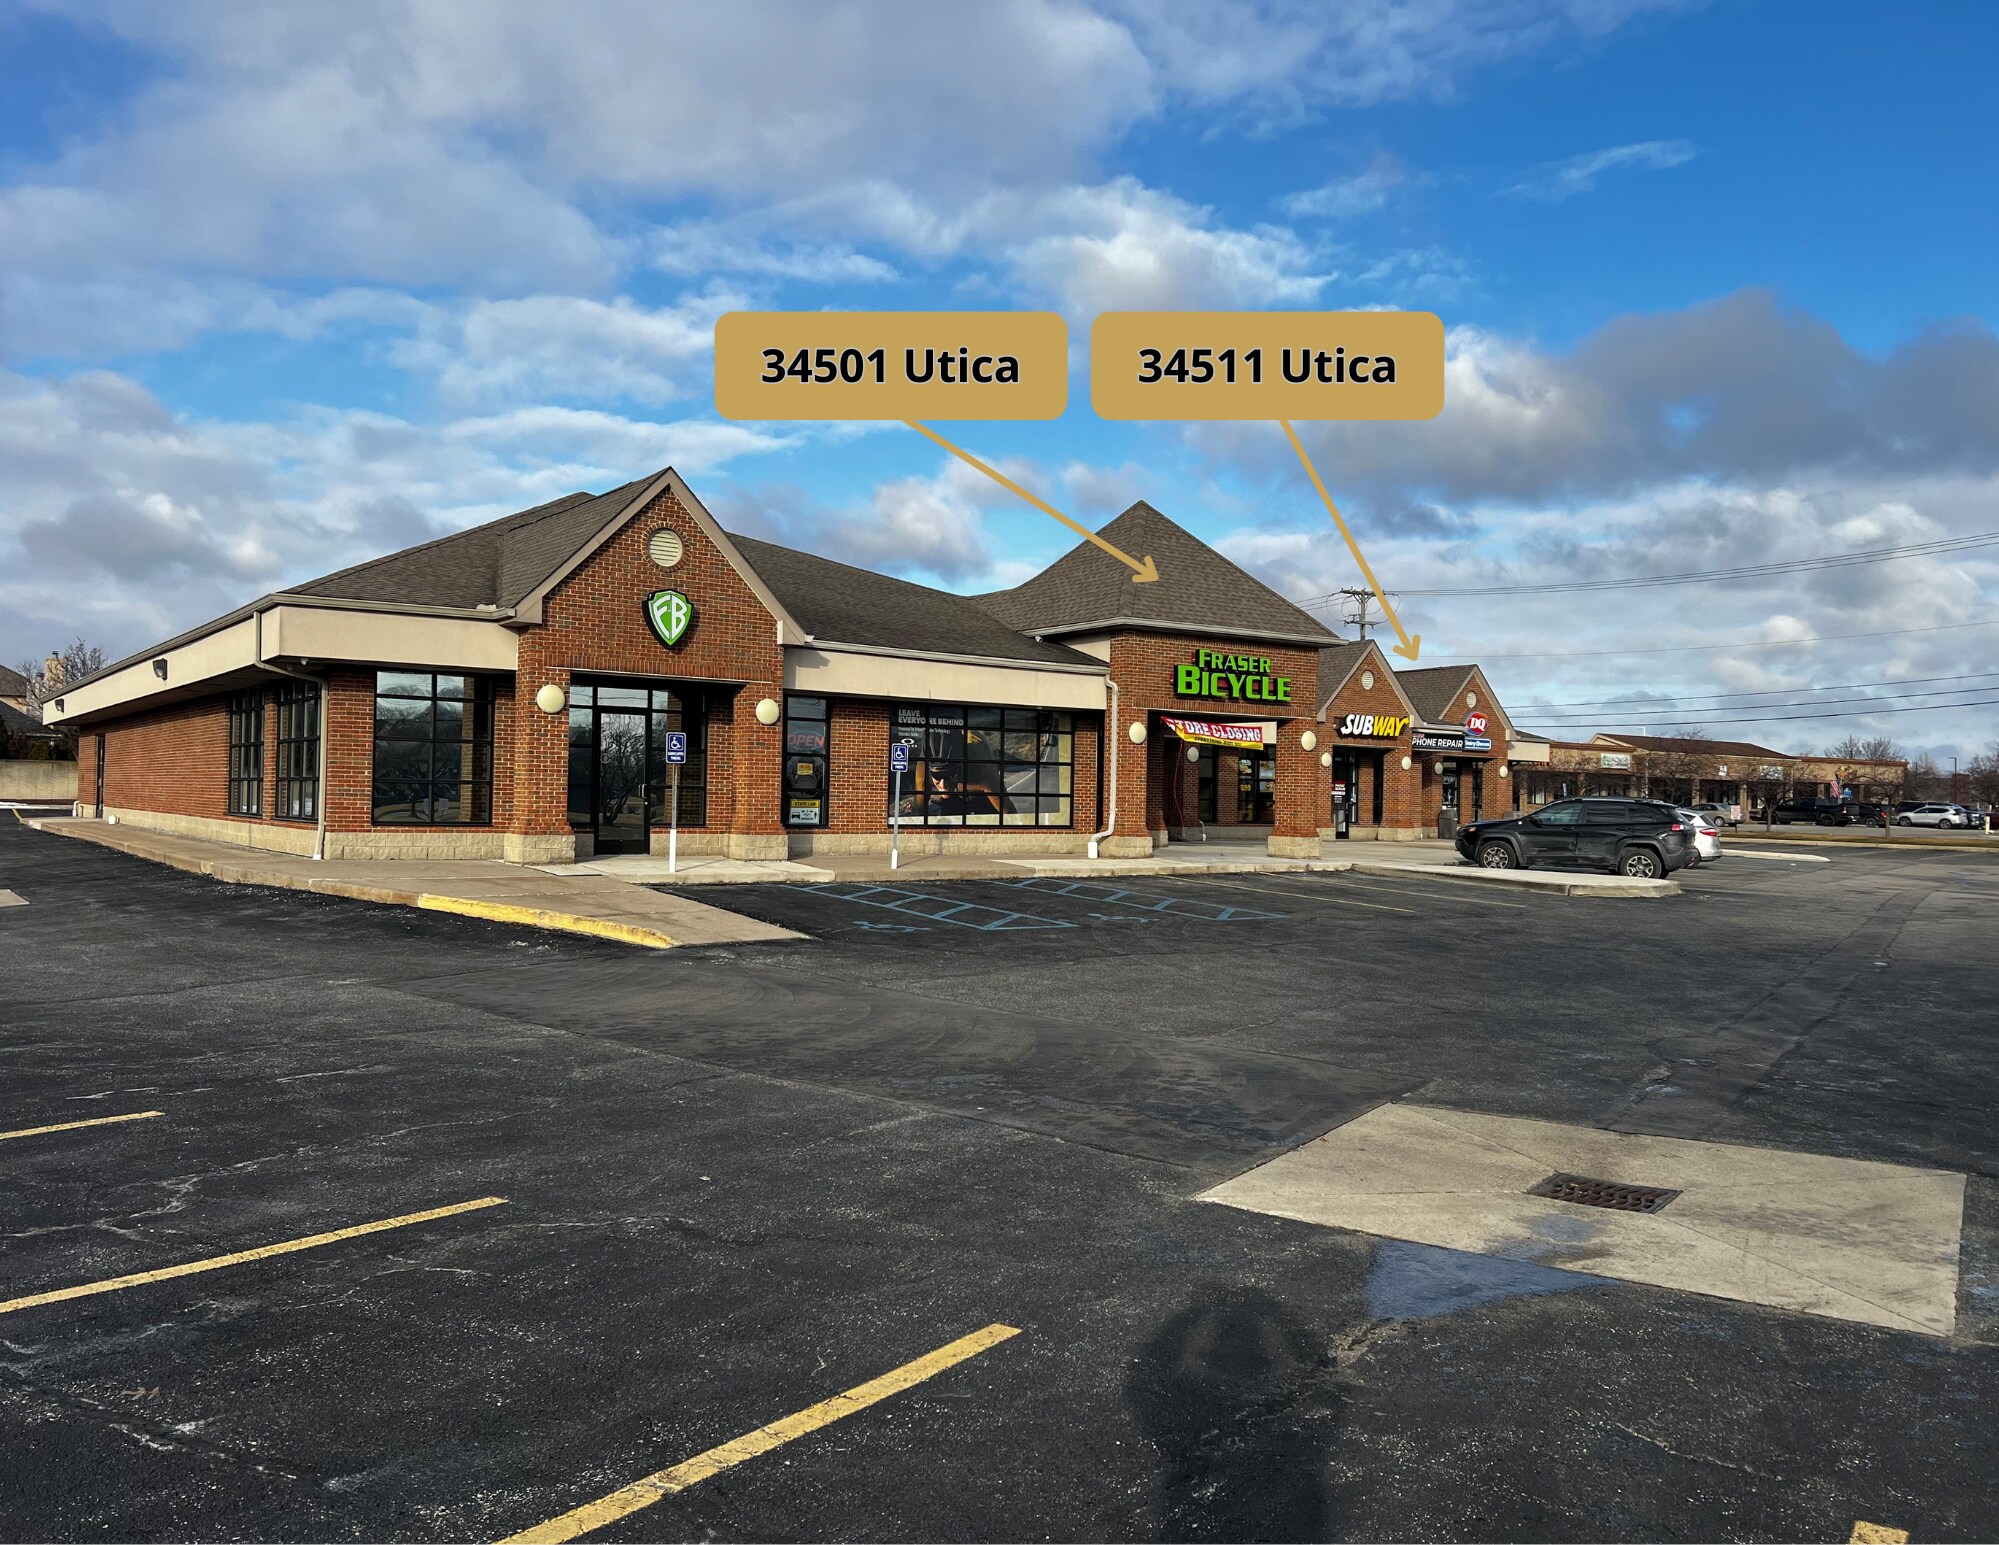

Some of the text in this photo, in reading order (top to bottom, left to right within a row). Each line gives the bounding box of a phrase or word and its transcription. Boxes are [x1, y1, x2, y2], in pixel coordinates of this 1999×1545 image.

[652, 594, 688, 640] FB
[1198, 649, 1271, 673] FRASER
[1177, 664, 1292, 701] BICYCLE
[898, 709, 921, 717] LEAVE
[937, 718, 965, 726] BEHIND
[1340, 714, 1410, 737] SUBWAY
[1470, 717, 1487, 732] DQ
[787, 734, 826, 748] OPEN
[1211, 725, 1261, 742] CLOSING
[1411, 737, 1464, 749] PHONE REPAIR
